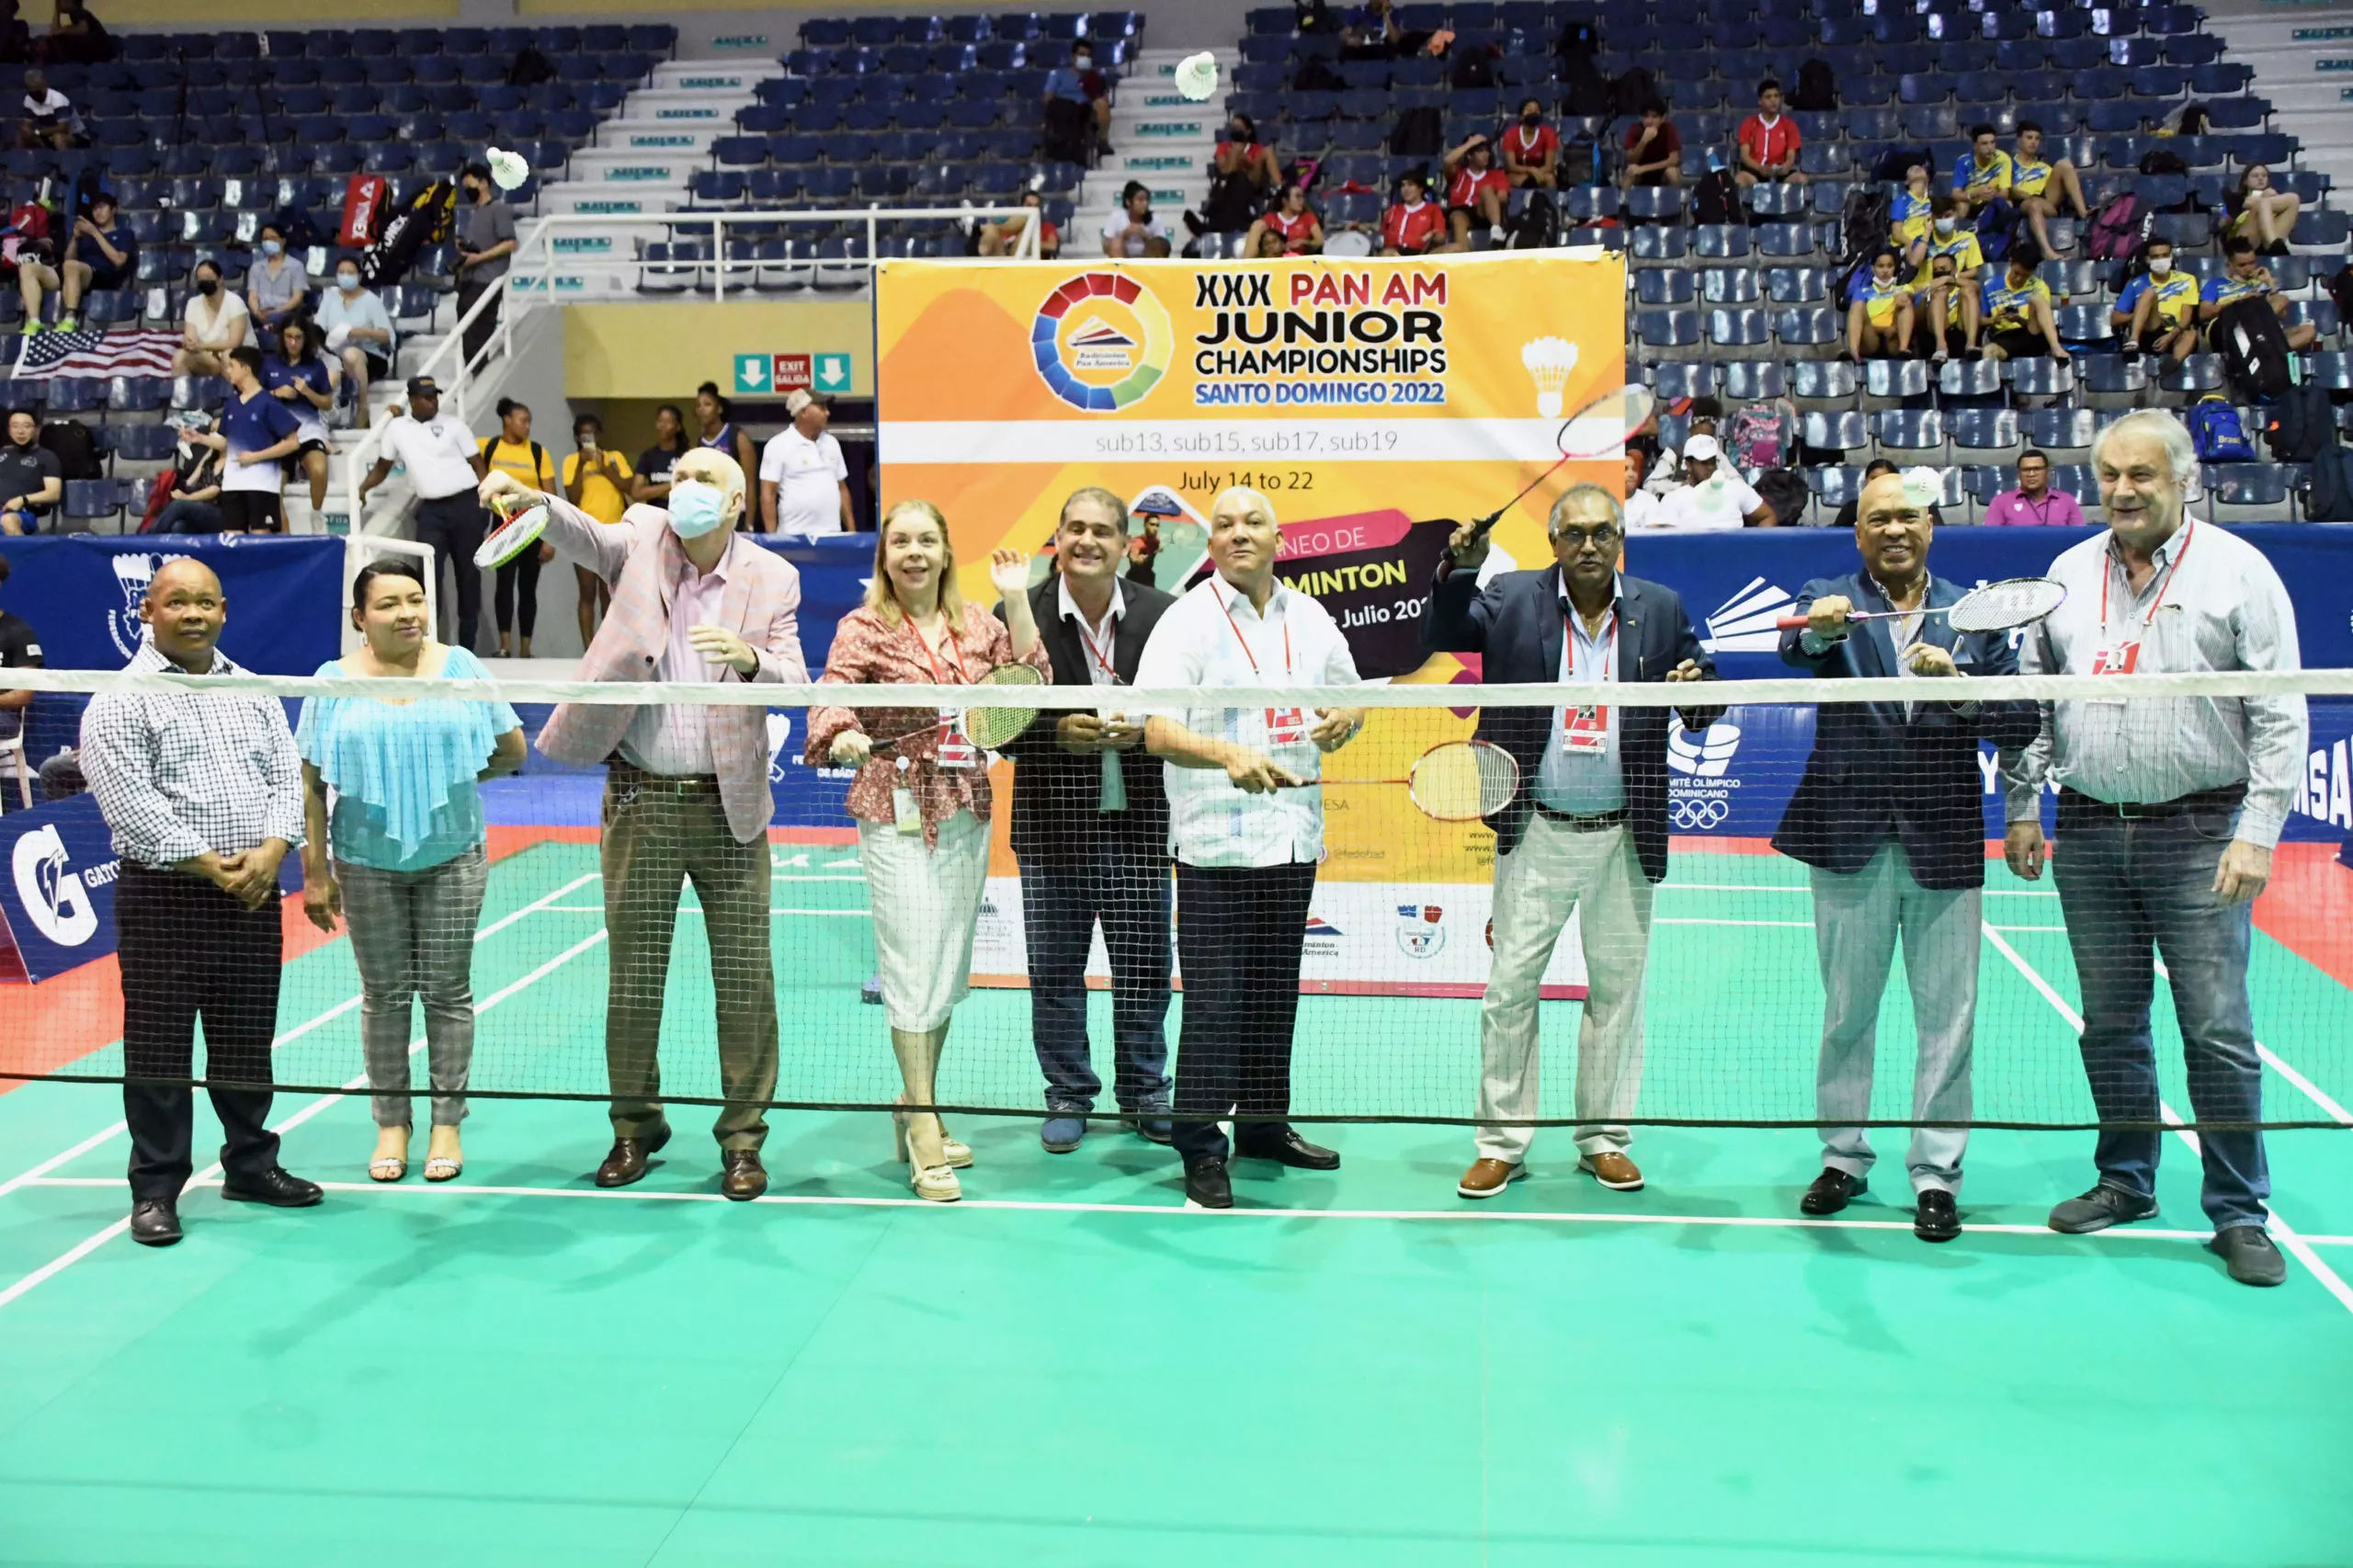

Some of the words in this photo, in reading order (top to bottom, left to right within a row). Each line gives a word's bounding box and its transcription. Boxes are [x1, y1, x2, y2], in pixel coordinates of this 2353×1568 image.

[1196, 274, 1271, 307] XXX
[1290, 273, 1369, 305] PAN
[1382, 272, 1447, 305] AM
[1196, 311, 1442, 345] JUNIOR
[779, 360, 806, 371] EXIT
[1195, 347, 1447, 375] CHAMPIONSHIPS
[776, 373, 810, 384] SALIDA
[1196, 382, 1270, 404] SANTO
[1276, 381, 1388, 404] DOMINGO
[1391, 381, 1446, 403] 2022
[1096, 432, 1168, 454] sub13,
[1173, 432, 1245, 454] sub15,
[1251, 431, 1324, 453] sub17,
[1330, 431, 1398, 452] sub19
[1178, 471, 1221, 494] July
[1228, 472, 1252, 489] 14
[1259, 472, 1281, 489] to
[1288, 472, 1313, 489] 22
[1277, 531, 1330, 557] NEO
[1335, 527, 1367, 549] DE
[1341, 604, 1390, 629] Julio
[1692, 778, 1742, 789] OLÍMPICO
